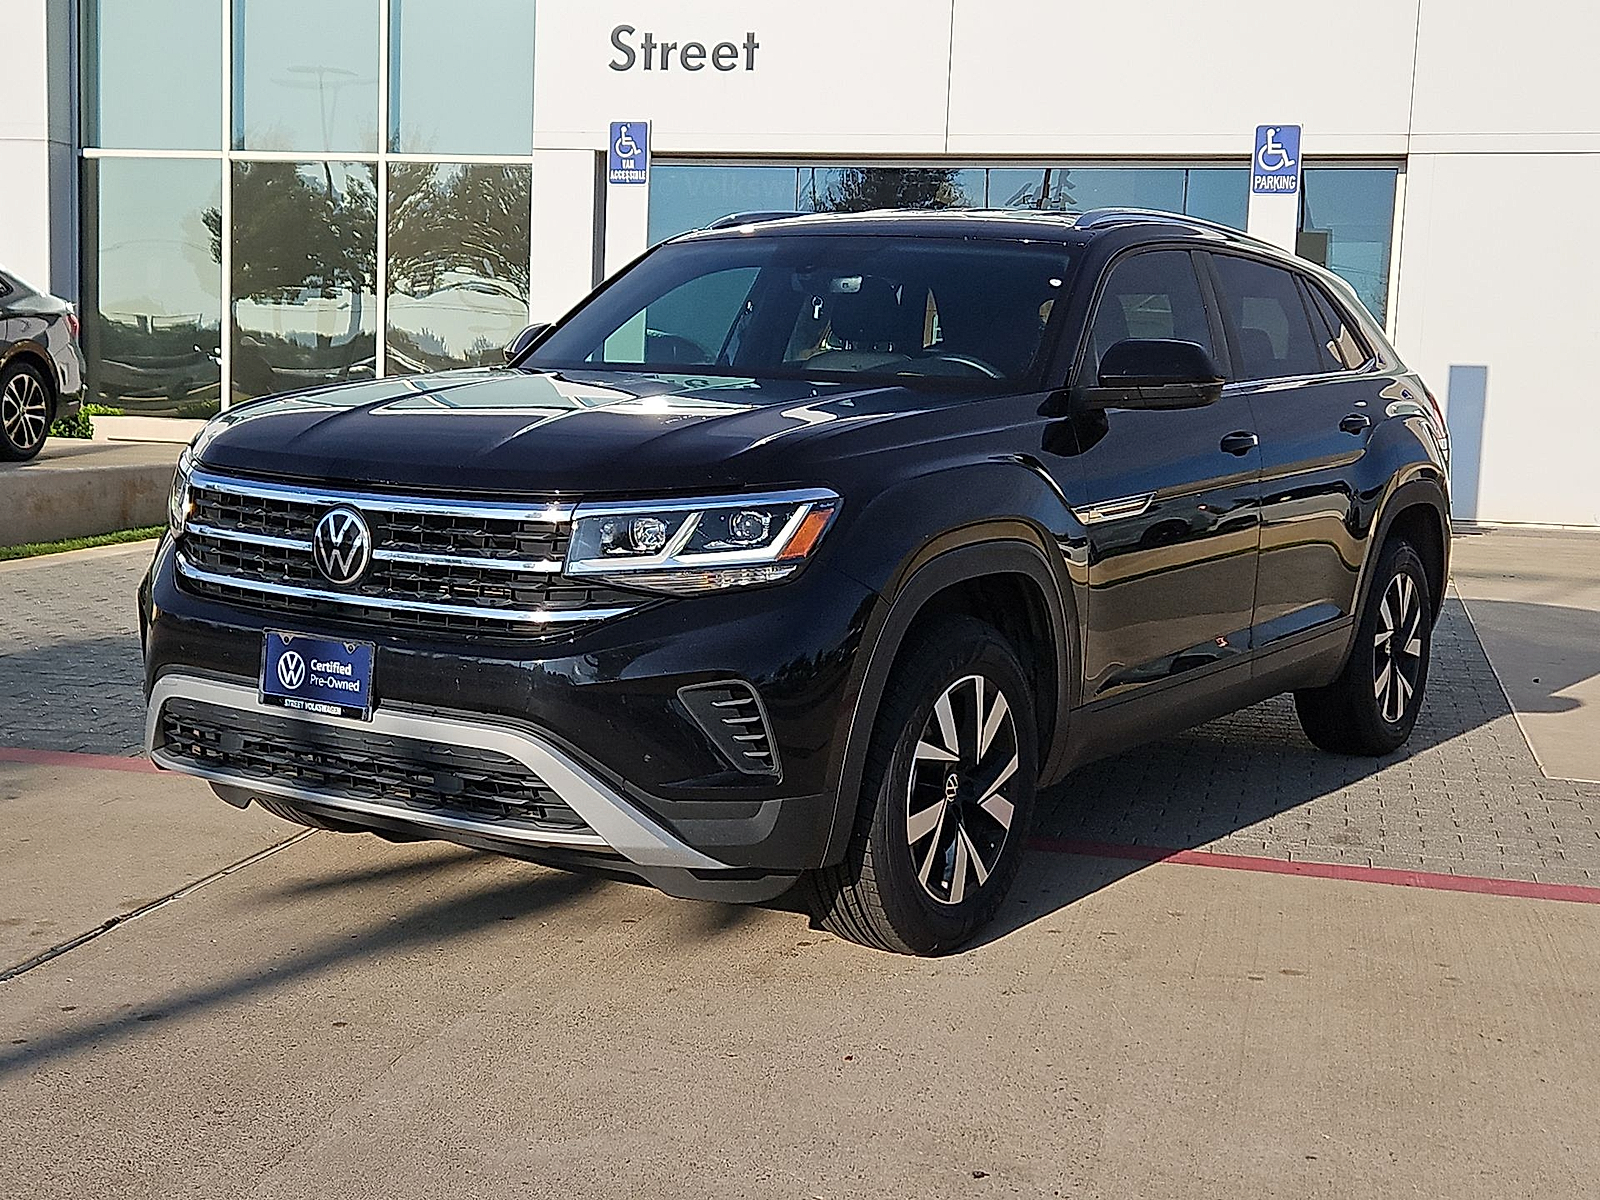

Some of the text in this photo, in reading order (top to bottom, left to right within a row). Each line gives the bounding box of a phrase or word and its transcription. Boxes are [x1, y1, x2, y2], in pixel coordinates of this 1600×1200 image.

[608, 24, 760, 71] Street
[1254, 175, 1296, 189] PARKING
[278, 651, 305, 689] VW
[310, 659, 352, 676] Certified
[309, 674, 360, 692] Pre-Owned
[284, 699, 304, 709] STREET
